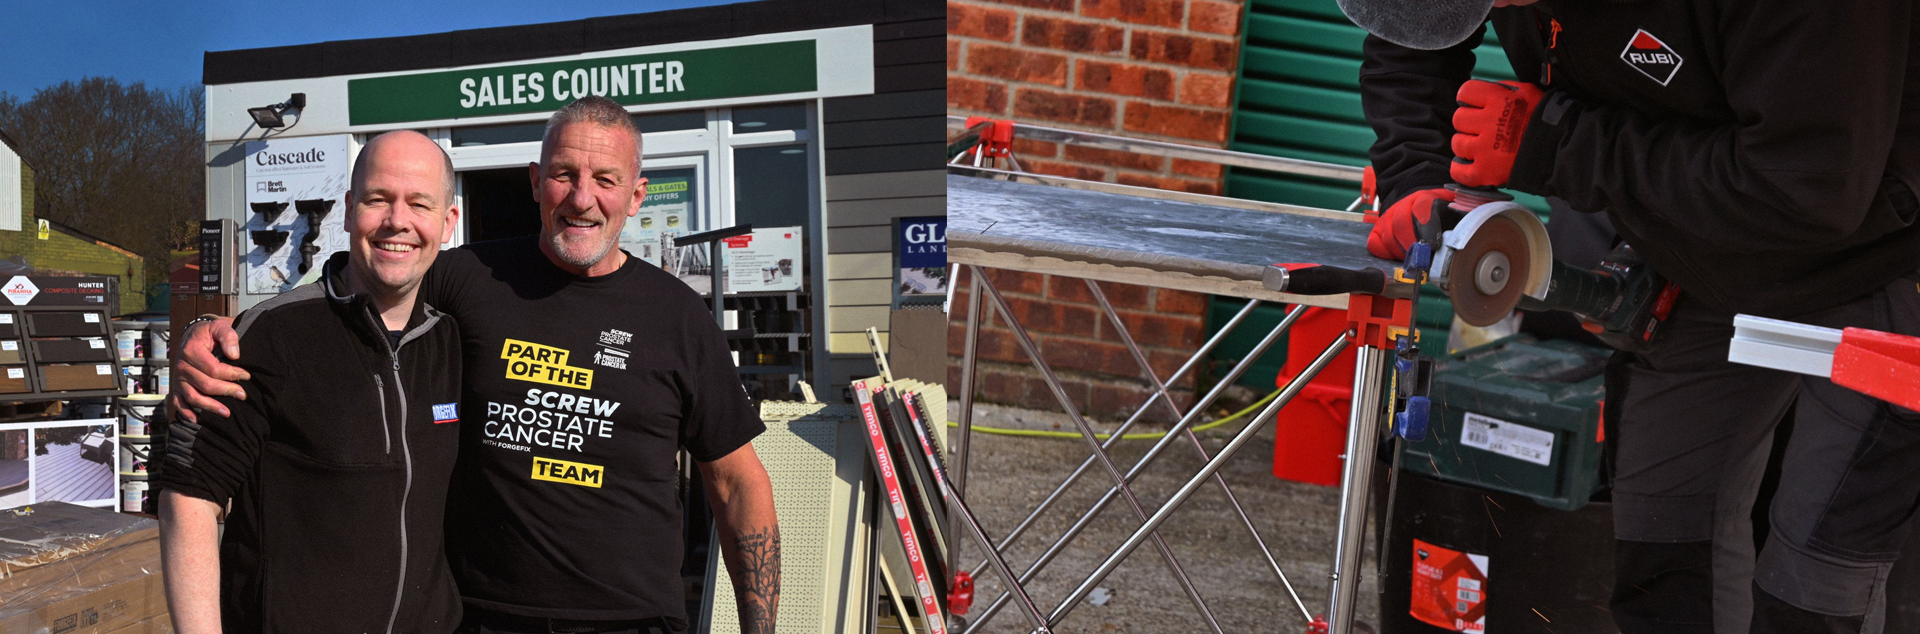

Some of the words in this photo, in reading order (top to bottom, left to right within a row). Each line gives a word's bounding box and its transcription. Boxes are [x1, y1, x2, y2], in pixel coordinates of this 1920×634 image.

[1629, 52, 1675, 65] RUBI
[459, 71, 545, 108] SALES
[552, 60, 685, 101] COUNTER
[256, 147, 325, 166] Cascade
[654, 192, 679, 200] OFFERS
[905, 223, 947, 244] GL
[600, 335, 625, 346] CANCER
[601, 330, 632, 343] PROSTATE
[611, 328, 633, 338] SCREW
[507, 343, 565, 365] PART
[511, 361, 542, 378] OF
[546, 366, 588, 386] THE
[524, 388, 621, 417] SCREW
[487, 401, 614, 438] PROSTATE
[482, 438, 497, 447] WITH
[497, 442, 532, 453] FORGEFIX
[484, 420, 584, 452] CANCER
[536, 460, 600, 484] TEAM
